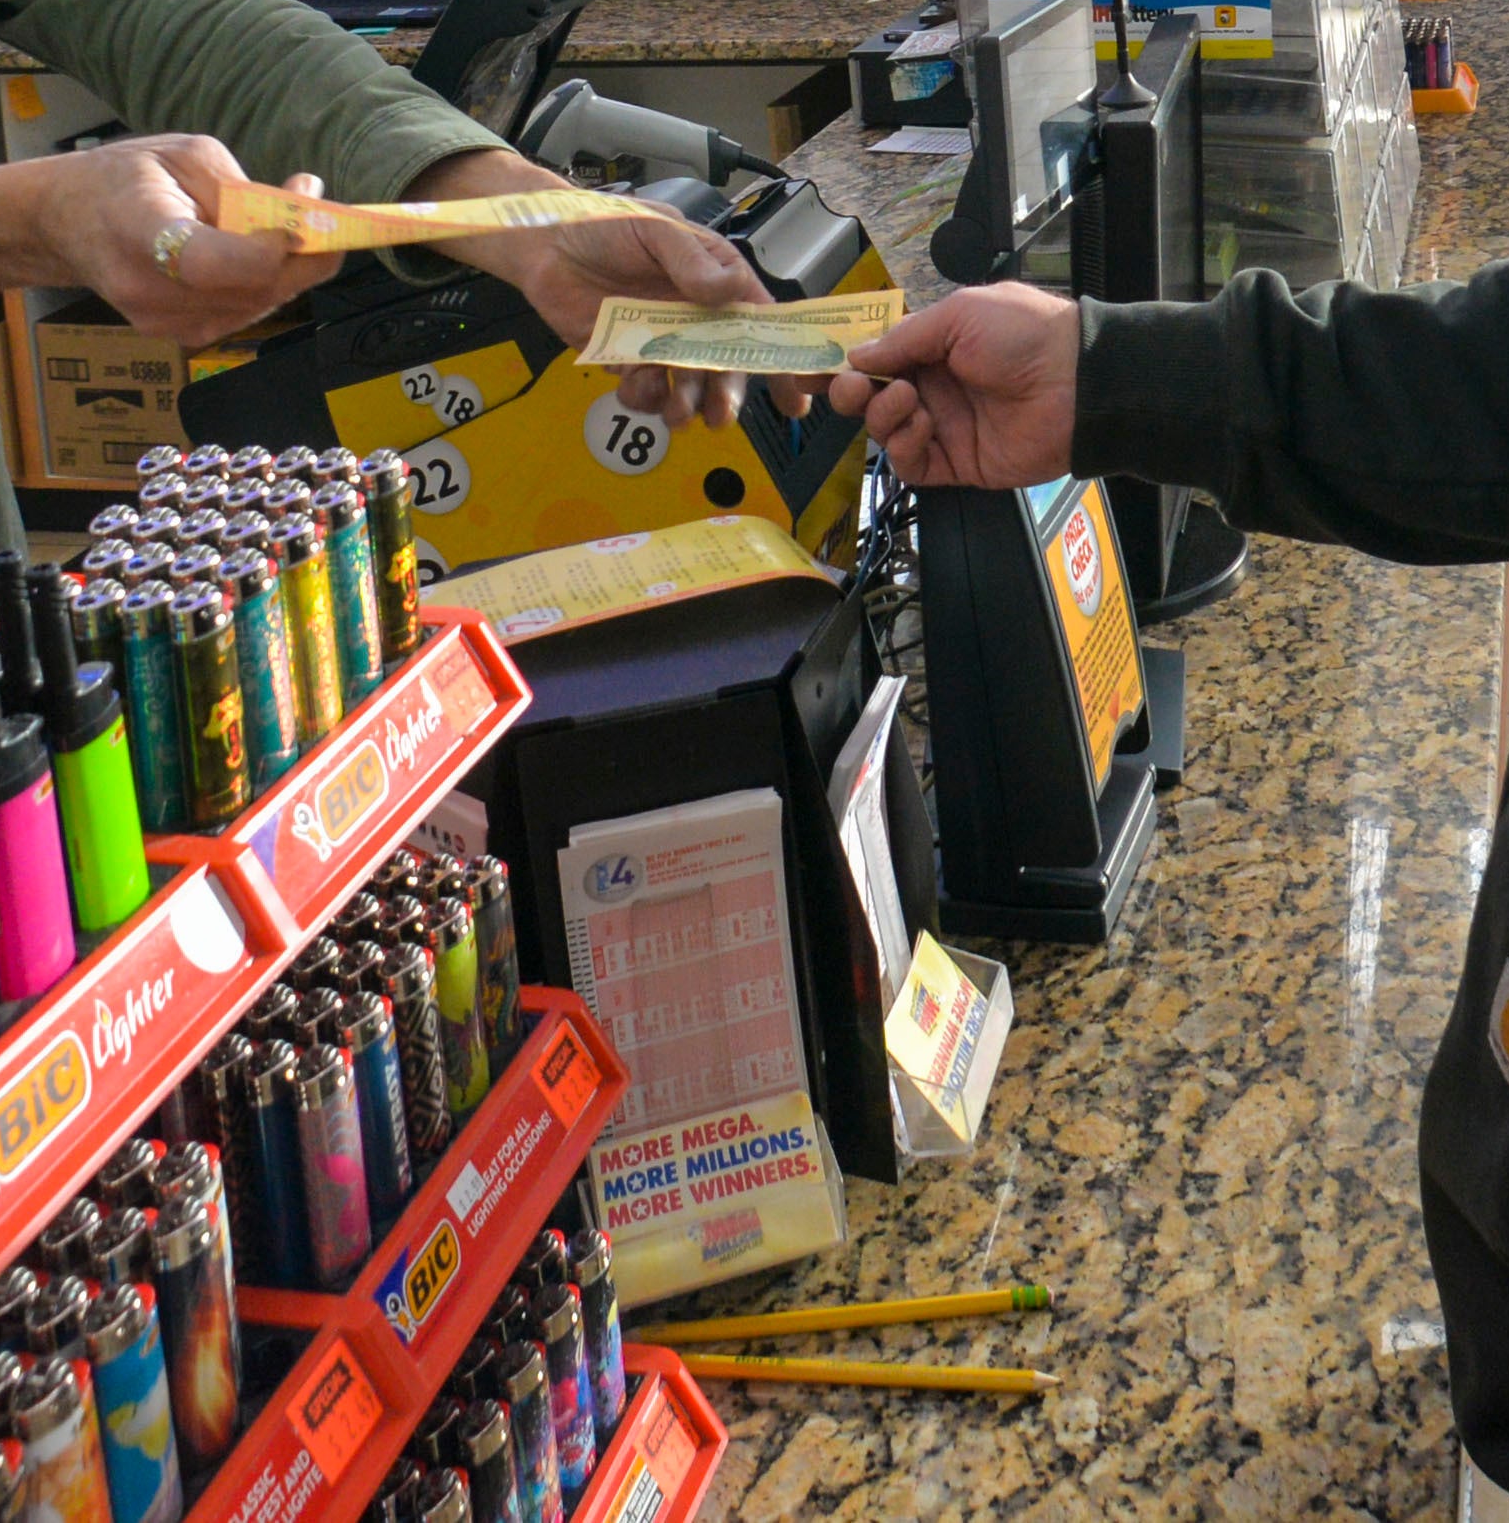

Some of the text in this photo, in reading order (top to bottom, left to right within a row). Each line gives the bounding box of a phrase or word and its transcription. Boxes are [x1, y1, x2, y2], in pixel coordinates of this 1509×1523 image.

[406, 371, 436, 401] 22
[440, 387, 477, 423] 18
[606, 414, 658, 467] 18
[408, 457, 460, 508] 22
[1063, 510, 1087, 555] PRIZE
[1070, 538, 1095, 582] CHECK
[610, 856, 636, 886] 4
[91, 968, 174, 1070] Lighter
[497, 1134, 518, 1166] FOR
[513, 1116, 533, 1146] ALL
[599, 1112, 764, 1175] MORE MEGA.
[604, 1126, 813, 1202] MORE MILLIONS.
[467, 1111, 553, 1238] LIGHTING OCCASIONS!
[608, 1151, 818, 1229] MORE WINNERS.
[284, 1449, 311, 1493] AND
